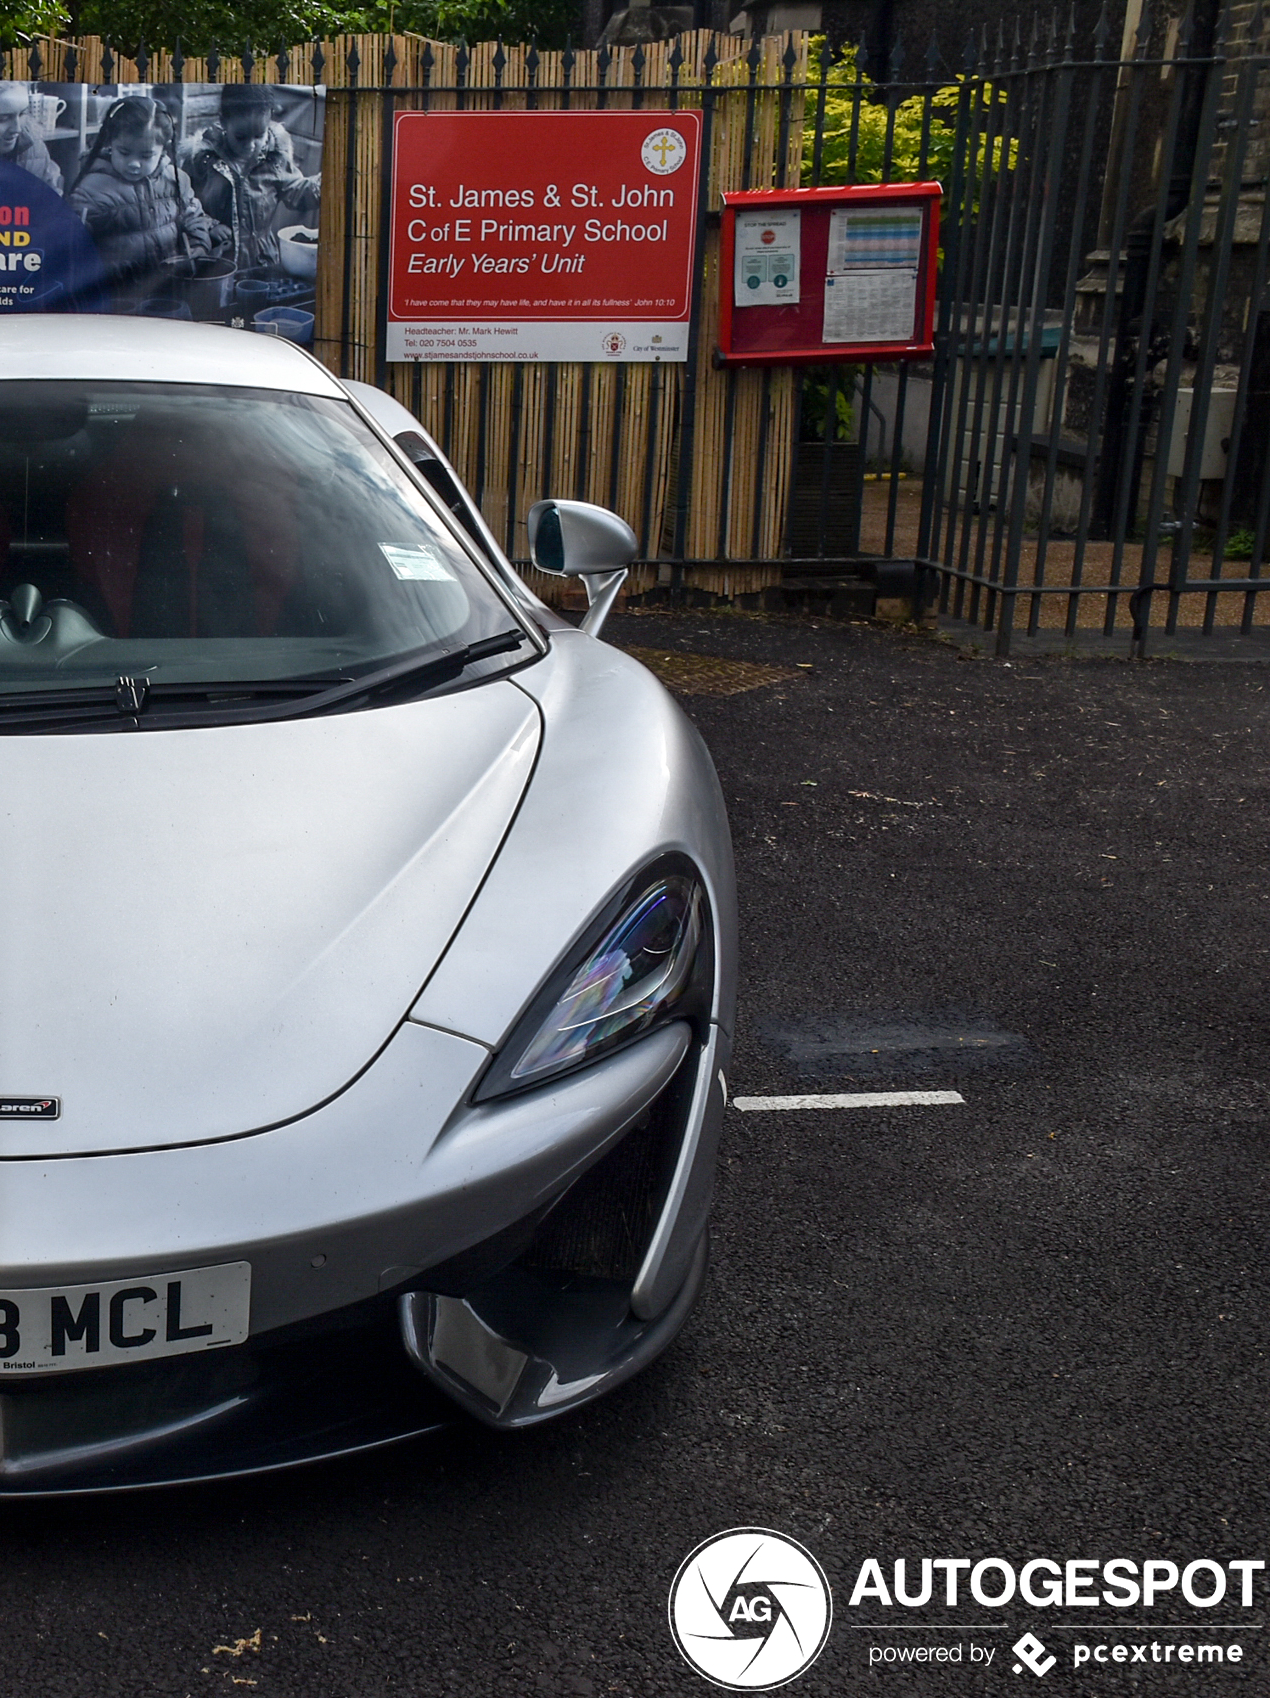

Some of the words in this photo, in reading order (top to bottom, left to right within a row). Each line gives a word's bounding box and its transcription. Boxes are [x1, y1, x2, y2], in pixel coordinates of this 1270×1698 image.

[408, 184, 442, 208] St.
[450, 184, 534, 208] James
[544, 184, 562, 207] &
[570, 184, 604, 207] St.
[612, 184, 674, 207] John
[408, 219, 426, 242] C
[430, 223, 450, 242] of
[455, 220, 472, 241] E
[481, 220, 576, 247] Primary
[584, 219, 668, 242] School
[408, 254, 466, 278] Early
[472, 254, 537, 273] Years’
[541, 254, 586, 273] Unit
[19, 284, 34, 294] for
[410, 299, 428, 307] have
[429, 299, 449, 307] come
[450, 299, 465, 307] that
[466, 299, 482, 308] they
[483, 299, 499, 308] may
[500, 299, 518, 307] have
[532, 299, 548, 307] and
[548, 299, 566, 307] have
[567, 299, 573, 307] it
[574, 299, 581, 307] in
[582, 299, 591, 307] all
[592, 299, 601, 307] its
[634, 299, 653, 307] John
[655, 299, 675, 307] 10:10
[404, 327, 456, 335] Headteacher:
[404, 352, 539, 360] www.stjamesandstjohnschool.co.uk
[51, 1281, 212, 1356] MCL
